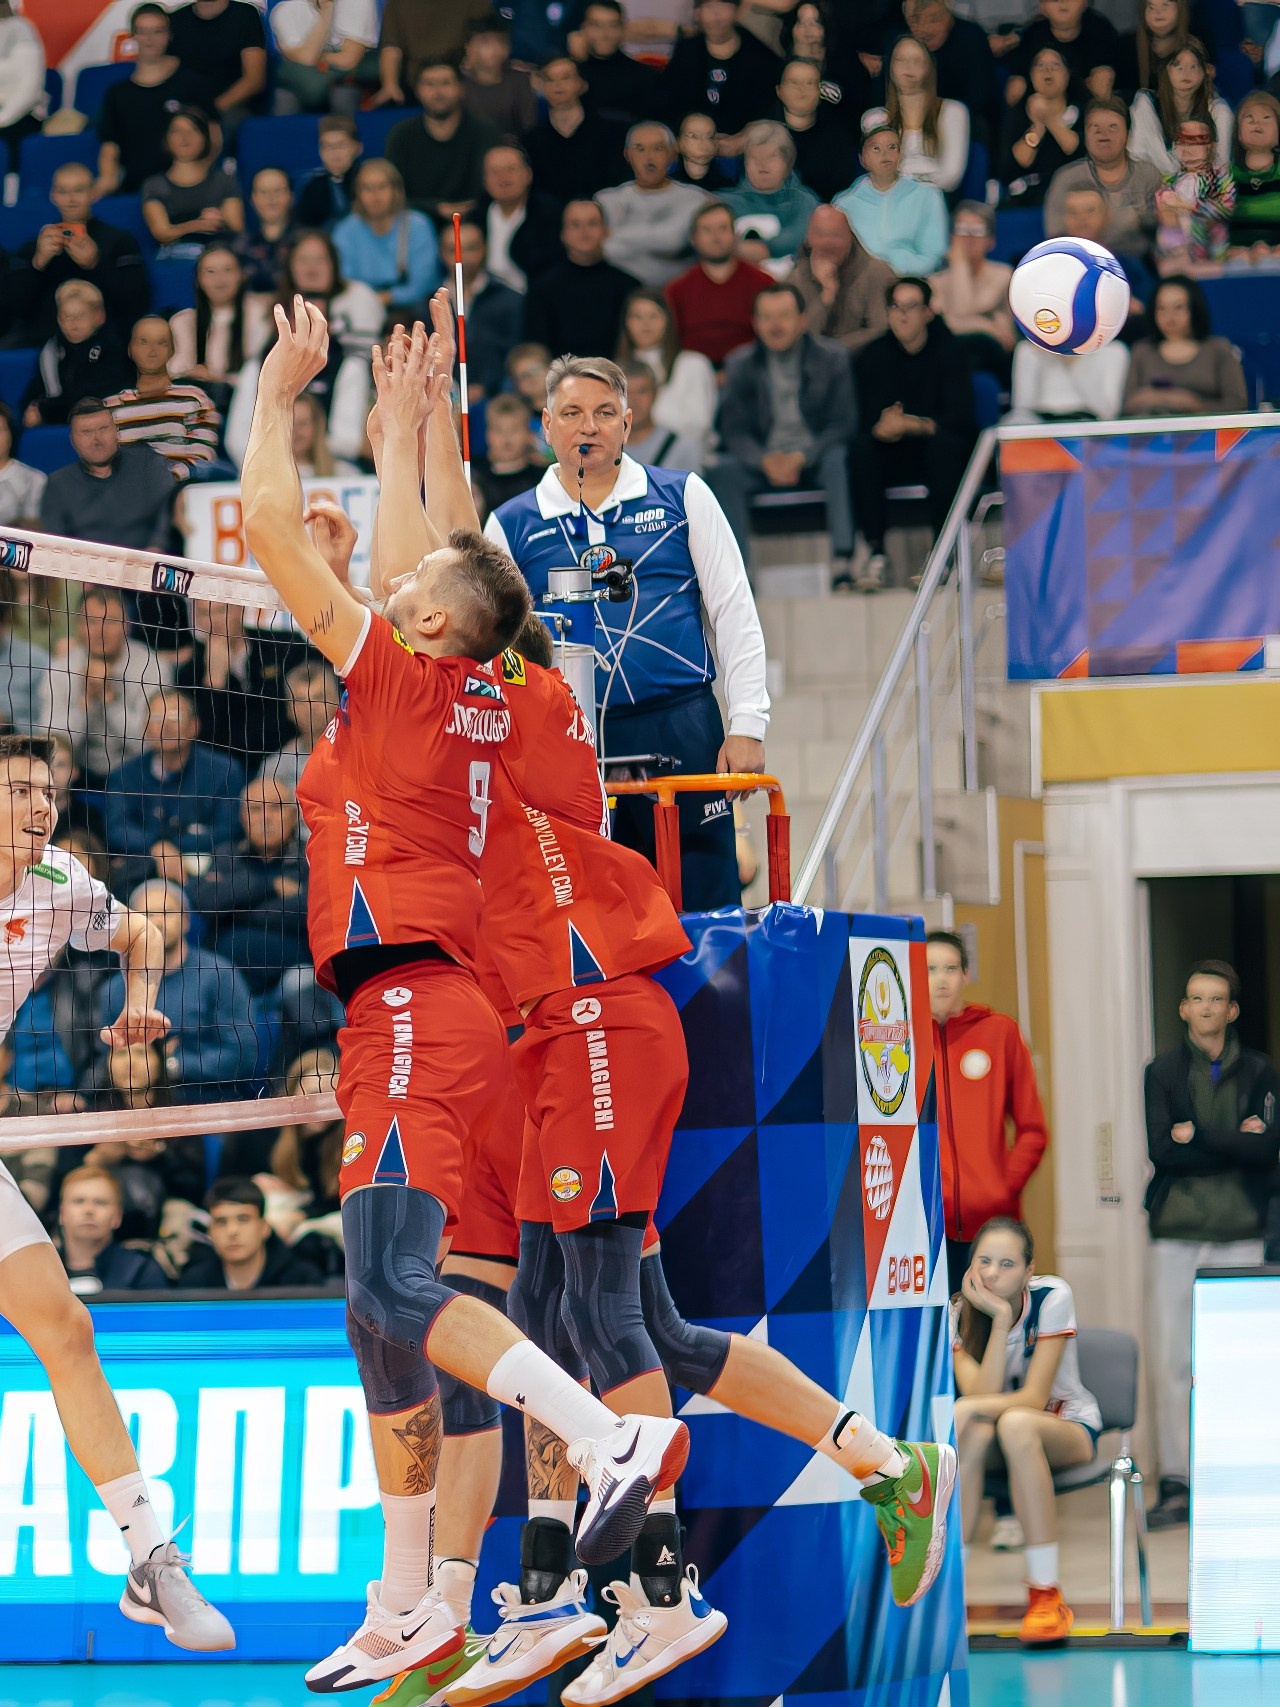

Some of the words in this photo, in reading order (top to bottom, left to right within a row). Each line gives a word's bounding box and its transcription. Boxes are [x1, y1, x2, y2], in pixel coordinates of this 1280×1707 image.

[634, 521, 667, 534] СУДЬЯ
[157, 566, 190, 595] PARI
[469, 761, 492, 858] 9
[585, 1026, 615, 1131] AMAGUCHI
